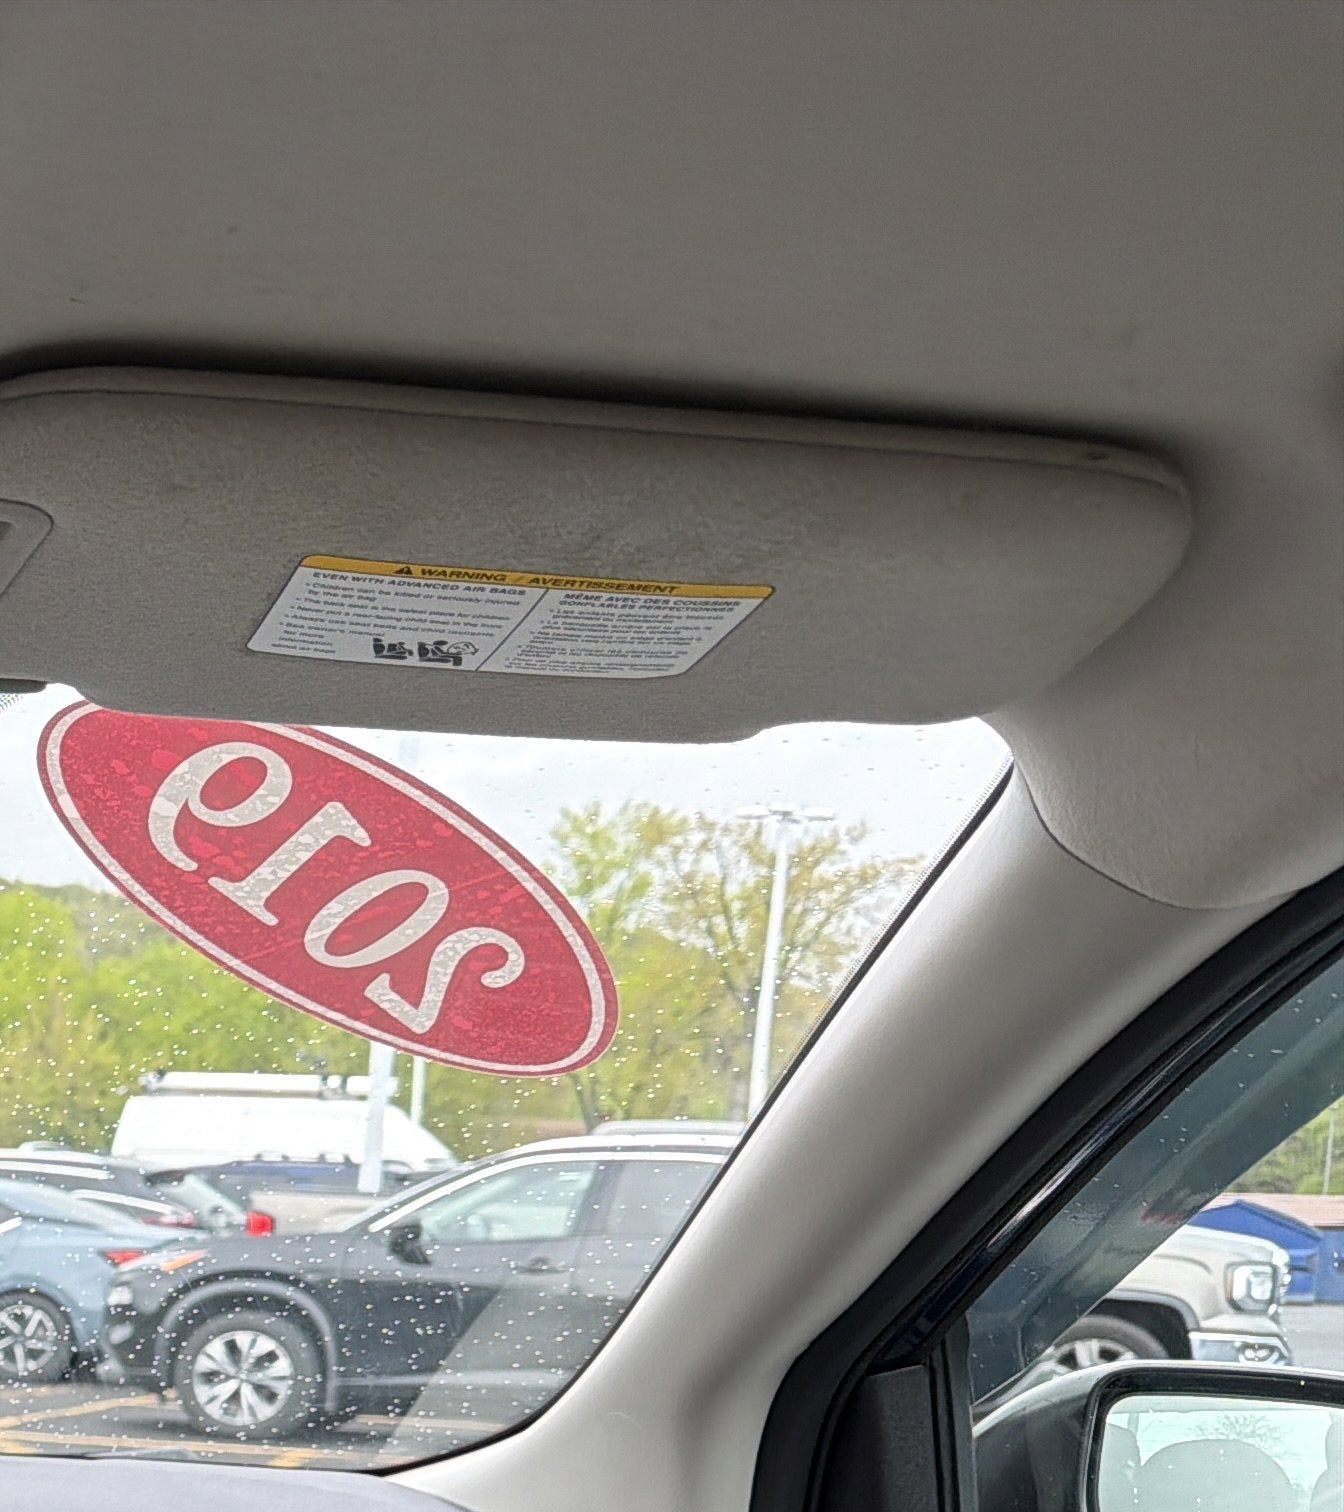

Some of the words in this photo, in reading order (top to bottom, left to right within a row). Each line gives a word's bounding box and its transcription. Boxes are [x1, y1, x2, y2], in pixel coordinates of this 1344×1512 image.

[313, 572, 349, 582] EVEN
[352, 576, 385, 585] WITH
[387, 579, 460, 591] ADVANCED
[462, 585, 486, 593] AIR
[489, 587, 527, 597] BAGS
[420, 568, 508, 583] WARNING
[528, 577, 680, 594] AVERTISSEMENT
